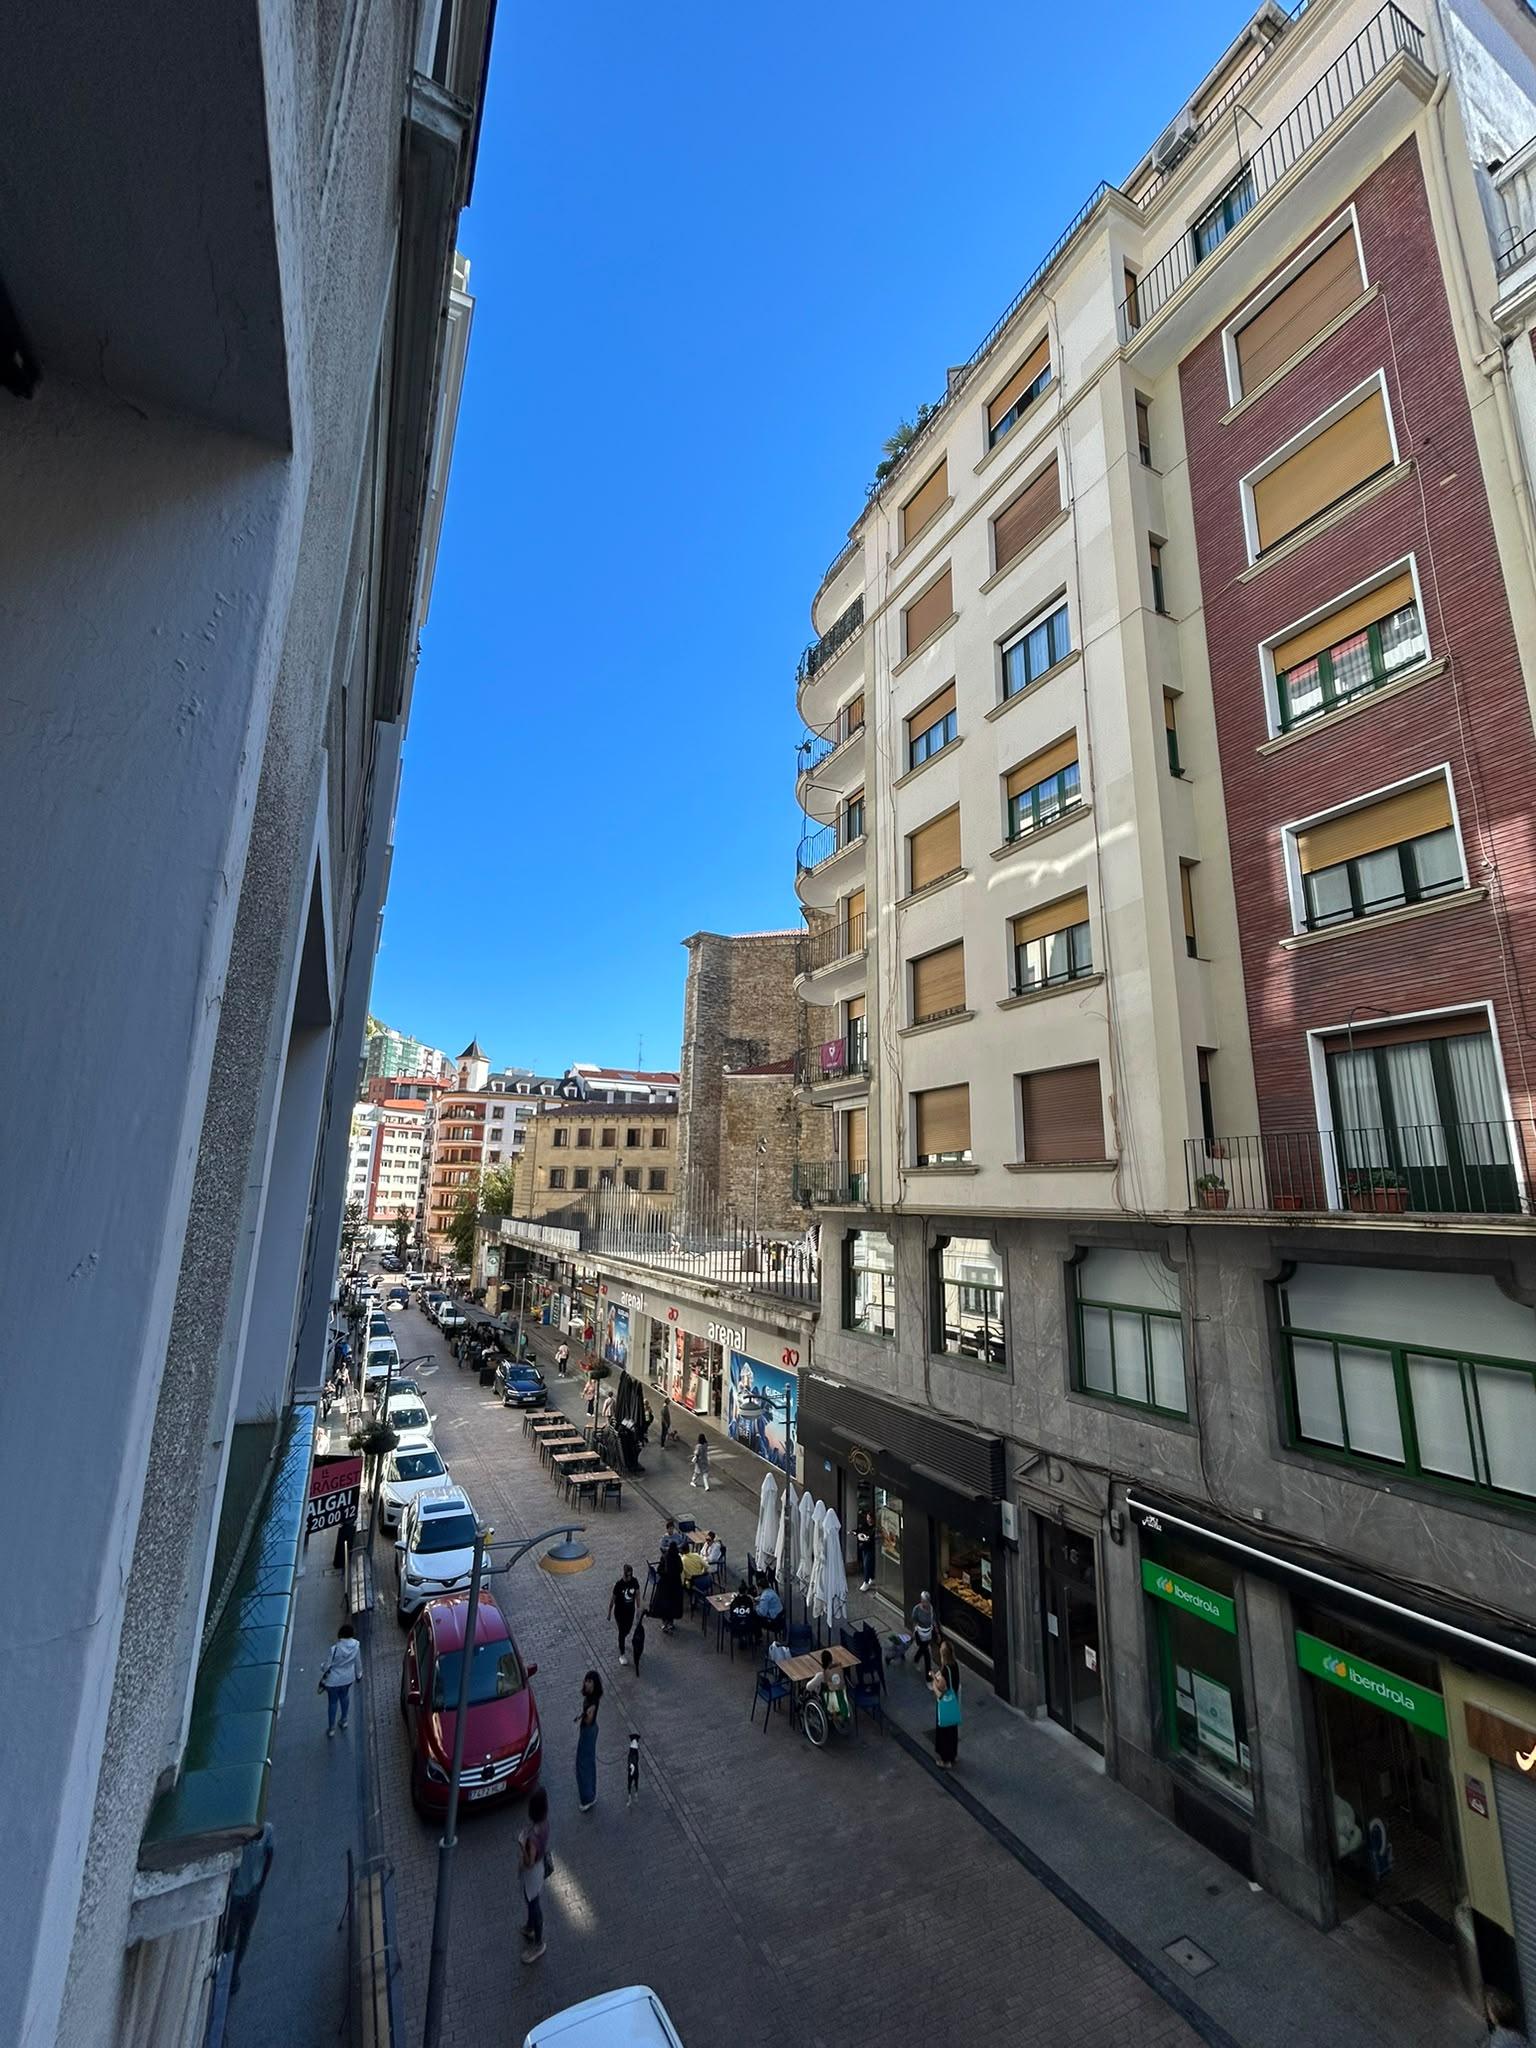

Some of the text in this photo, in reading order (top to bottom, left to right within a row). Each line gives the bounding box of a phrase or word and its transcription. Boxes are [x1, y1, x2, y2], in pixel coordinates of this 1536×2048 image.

[621, 1291, 644, 1311] arenal
[708, 1321, 746, 1351] arenal
[311, 1505, 356, 1530] 20 00 12
[1174, 1584, 1220, 1617] Iberdrola
[1349, 1667, 1415, 1710] Iberdrola
